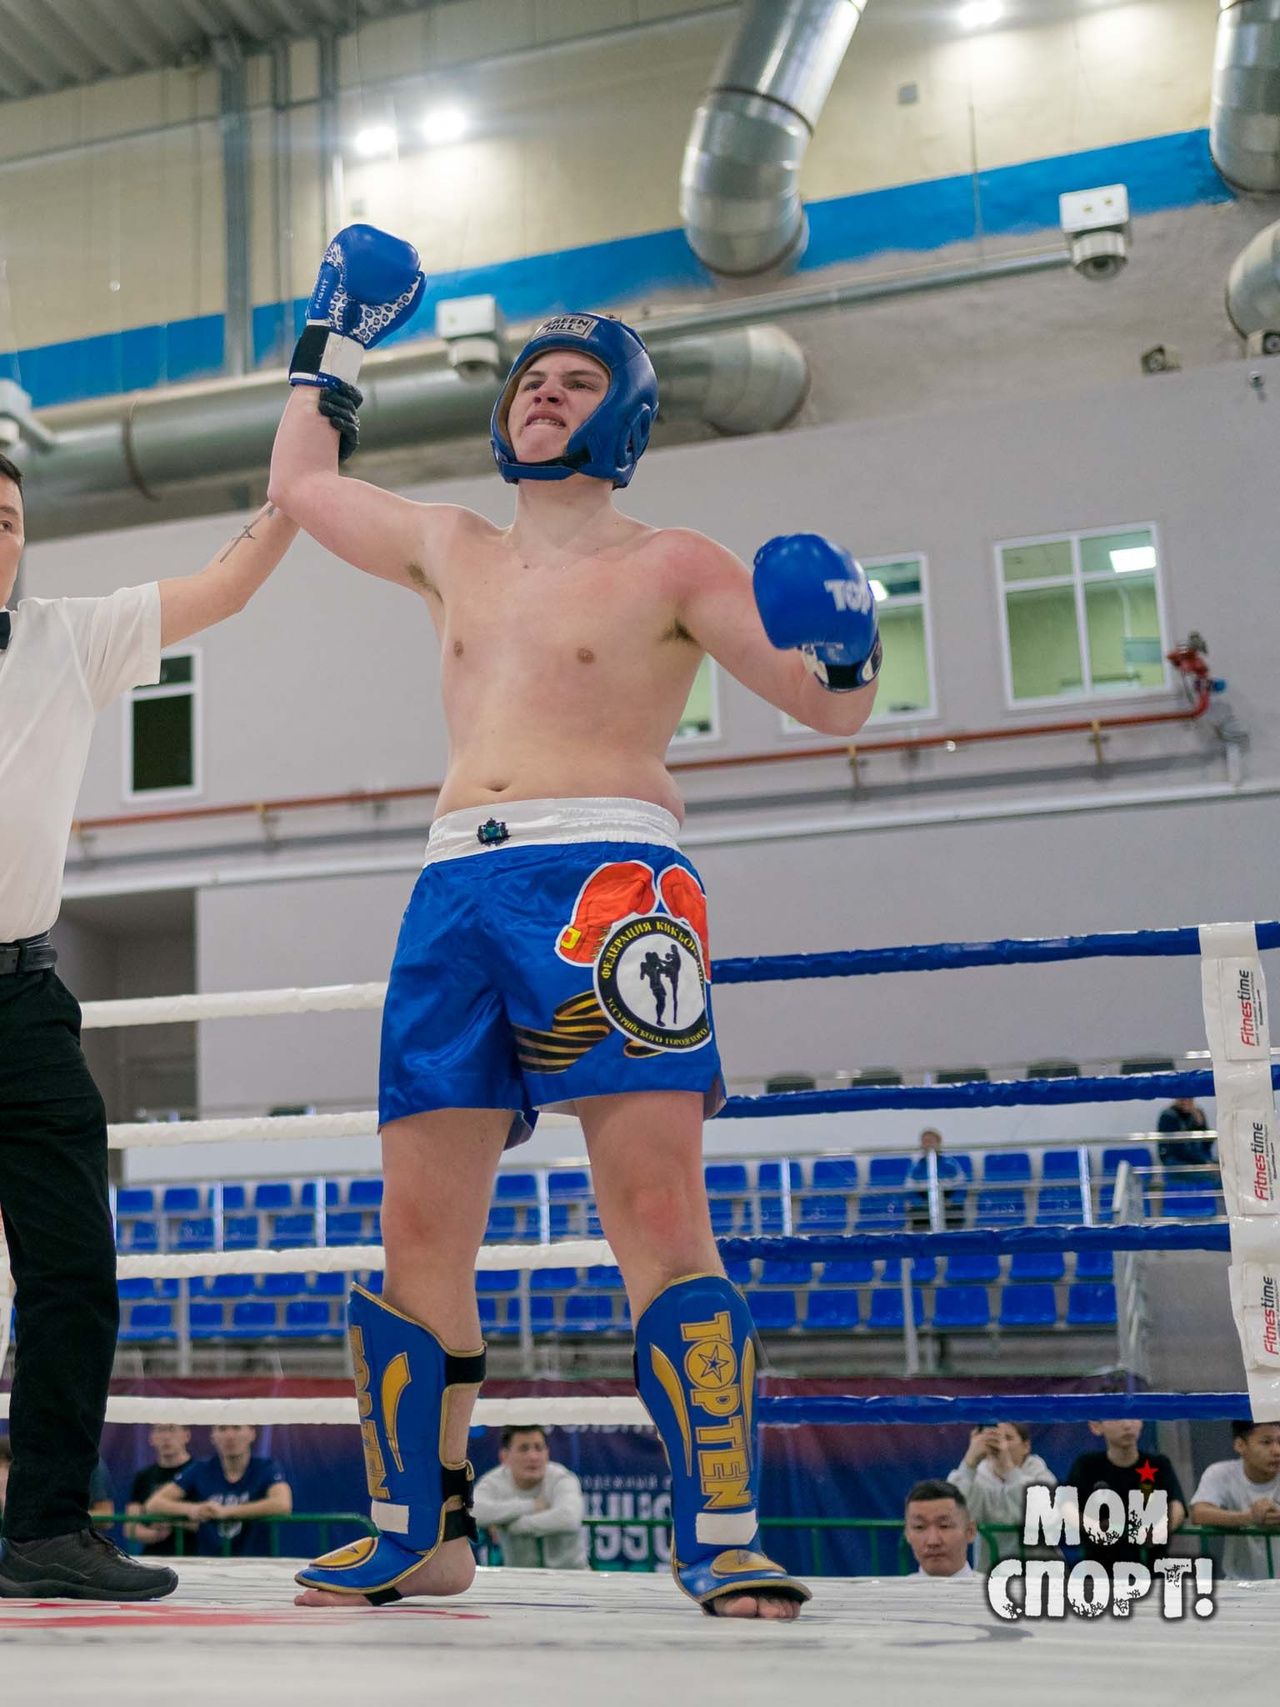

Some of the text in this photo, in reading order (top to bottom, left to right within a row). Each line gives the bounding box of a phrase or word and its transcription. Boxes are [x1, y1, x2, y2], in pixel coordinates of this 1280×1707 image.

[314, 279, 329, 309] FIGHT
[546, 323, 575, 332] HILL
[601, 921, 652, 979] ФЕДЕРАЦИЯ
[1239, 969, 1256, 1047] Fitnestime
[1251, 1122, 1269, 1201] Fitnestime
[1261, 1276, 1279, 1355] Fitnestime
[680, 1311, 751, 1510] TOP TEN
